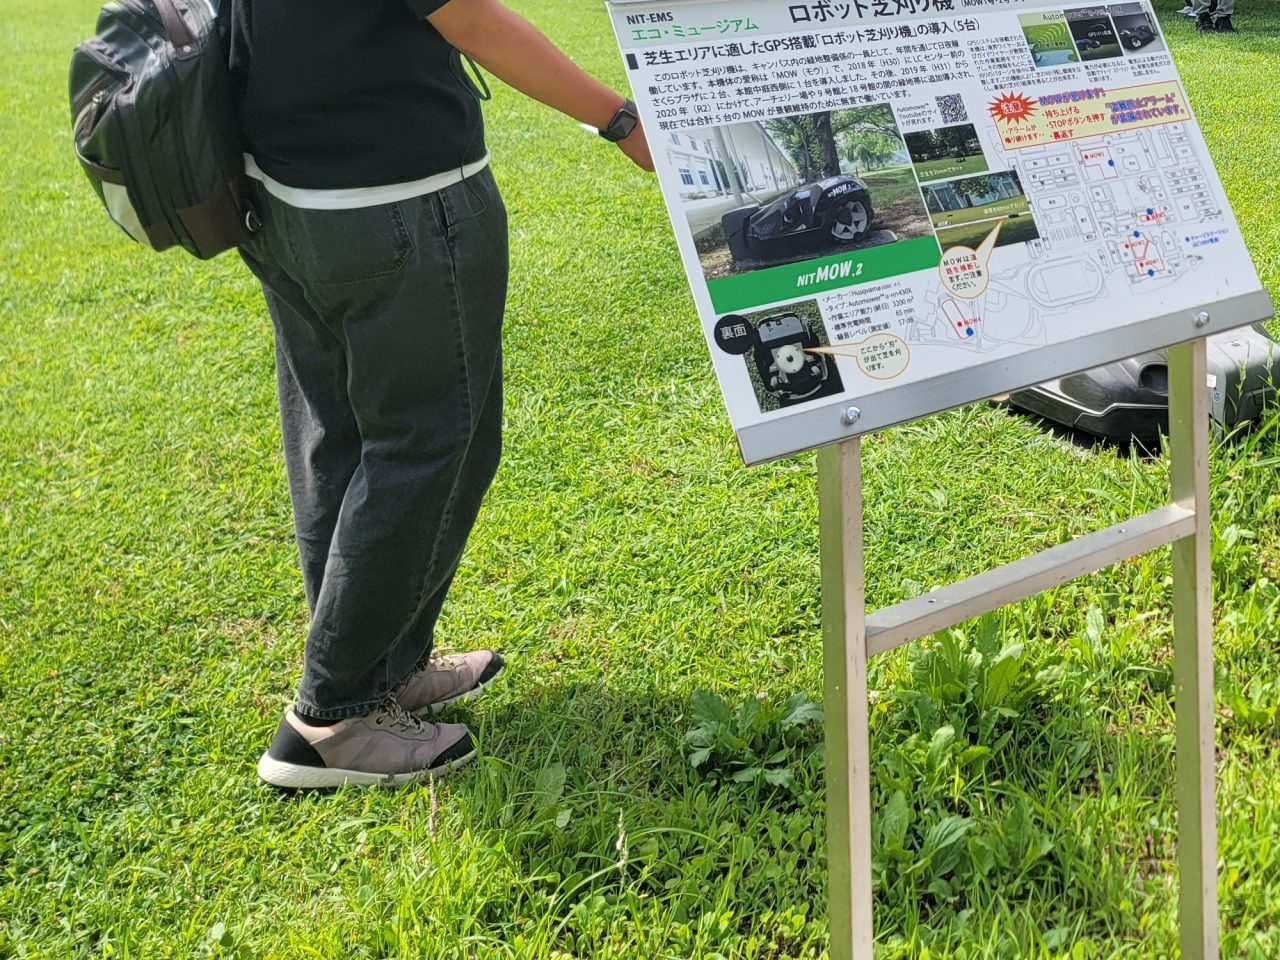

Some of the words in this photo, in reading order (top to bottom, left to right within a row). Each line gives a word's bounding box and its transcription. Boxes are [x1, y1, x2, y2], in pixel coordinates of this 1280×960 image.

[626, 11, 674, 25] NIT-EMS
[631, 16, 758, 42] エコ・ミュージアム
[1001, 100, 1023, 115] 注意
[720, 322, 747, 340] 裏面
